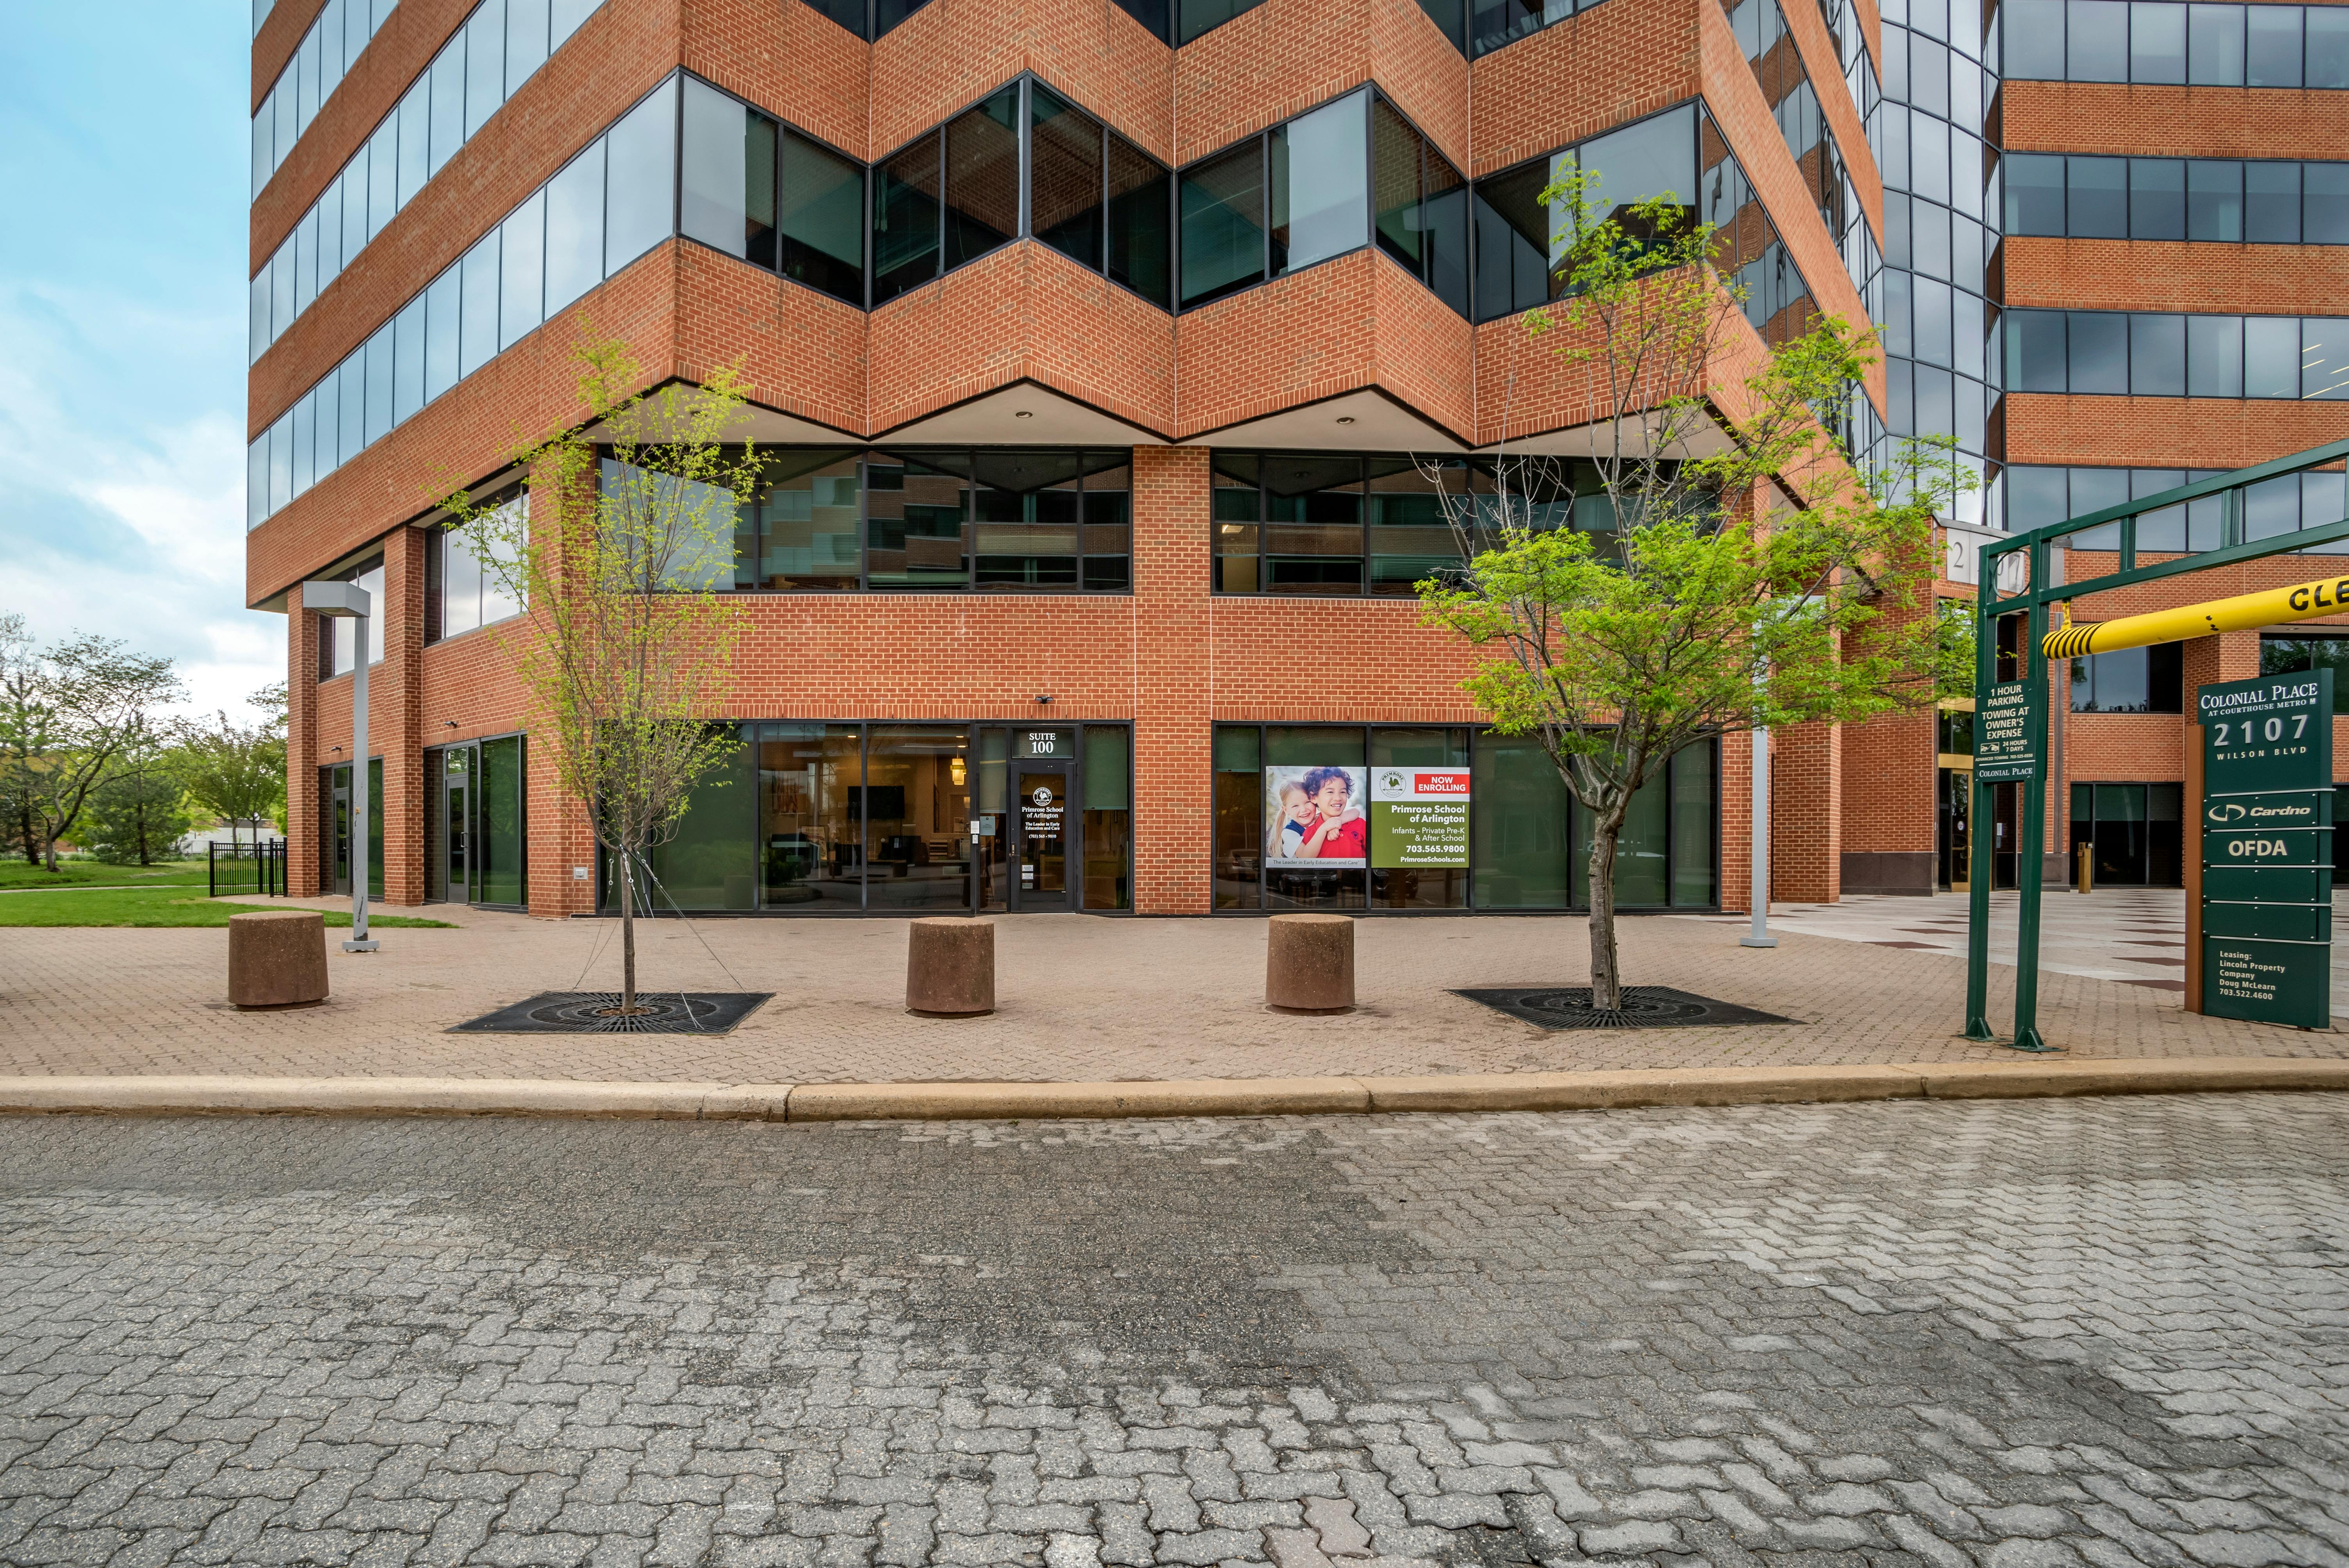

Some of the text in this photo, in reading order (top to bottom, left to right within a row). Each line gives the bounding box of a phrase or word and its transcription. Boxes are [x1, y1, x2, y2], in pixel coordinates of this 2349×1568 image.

[1998, 685, 2022, 695] HOUR
[2201, 683, 2318, 709] COLONIAL PLACE
[1988, 695, 2023, 707] PARKING
[2220, 703, 2274, 715] COURTHOUSE
[2277, 699, 2306, 709] METRO
[1982, 707, 2030, 720] TOWING AT
[1986, 718, 2024, 730] OWNER'S
[1987, 728, 2022, 739] EXPENSE
[2214, 714, 2308, 747] 2107
[1032, 741, 1053, 753] 100
[2217, 747, 2307, 760] WILSON BLVD
[1382, 772, 1404, 781] PRIMROSE
[1392, 805, 1465, 813] Primrose School
[2250, 806, 2310, 816] Cardno
[1410, 814, 1465, 824] of Arlington
[2228, 840, 2288, 856] OFDA
[2220, 951, 2252, 960] Leasing:
[2220, 960, 2285, 973] Lincoln Property
[2220, 970, 2255, 980] Company
[2219, 979, 2276, 990] Doug McLearn
[2219, 988, 2272, 1000] 703.522.4600
